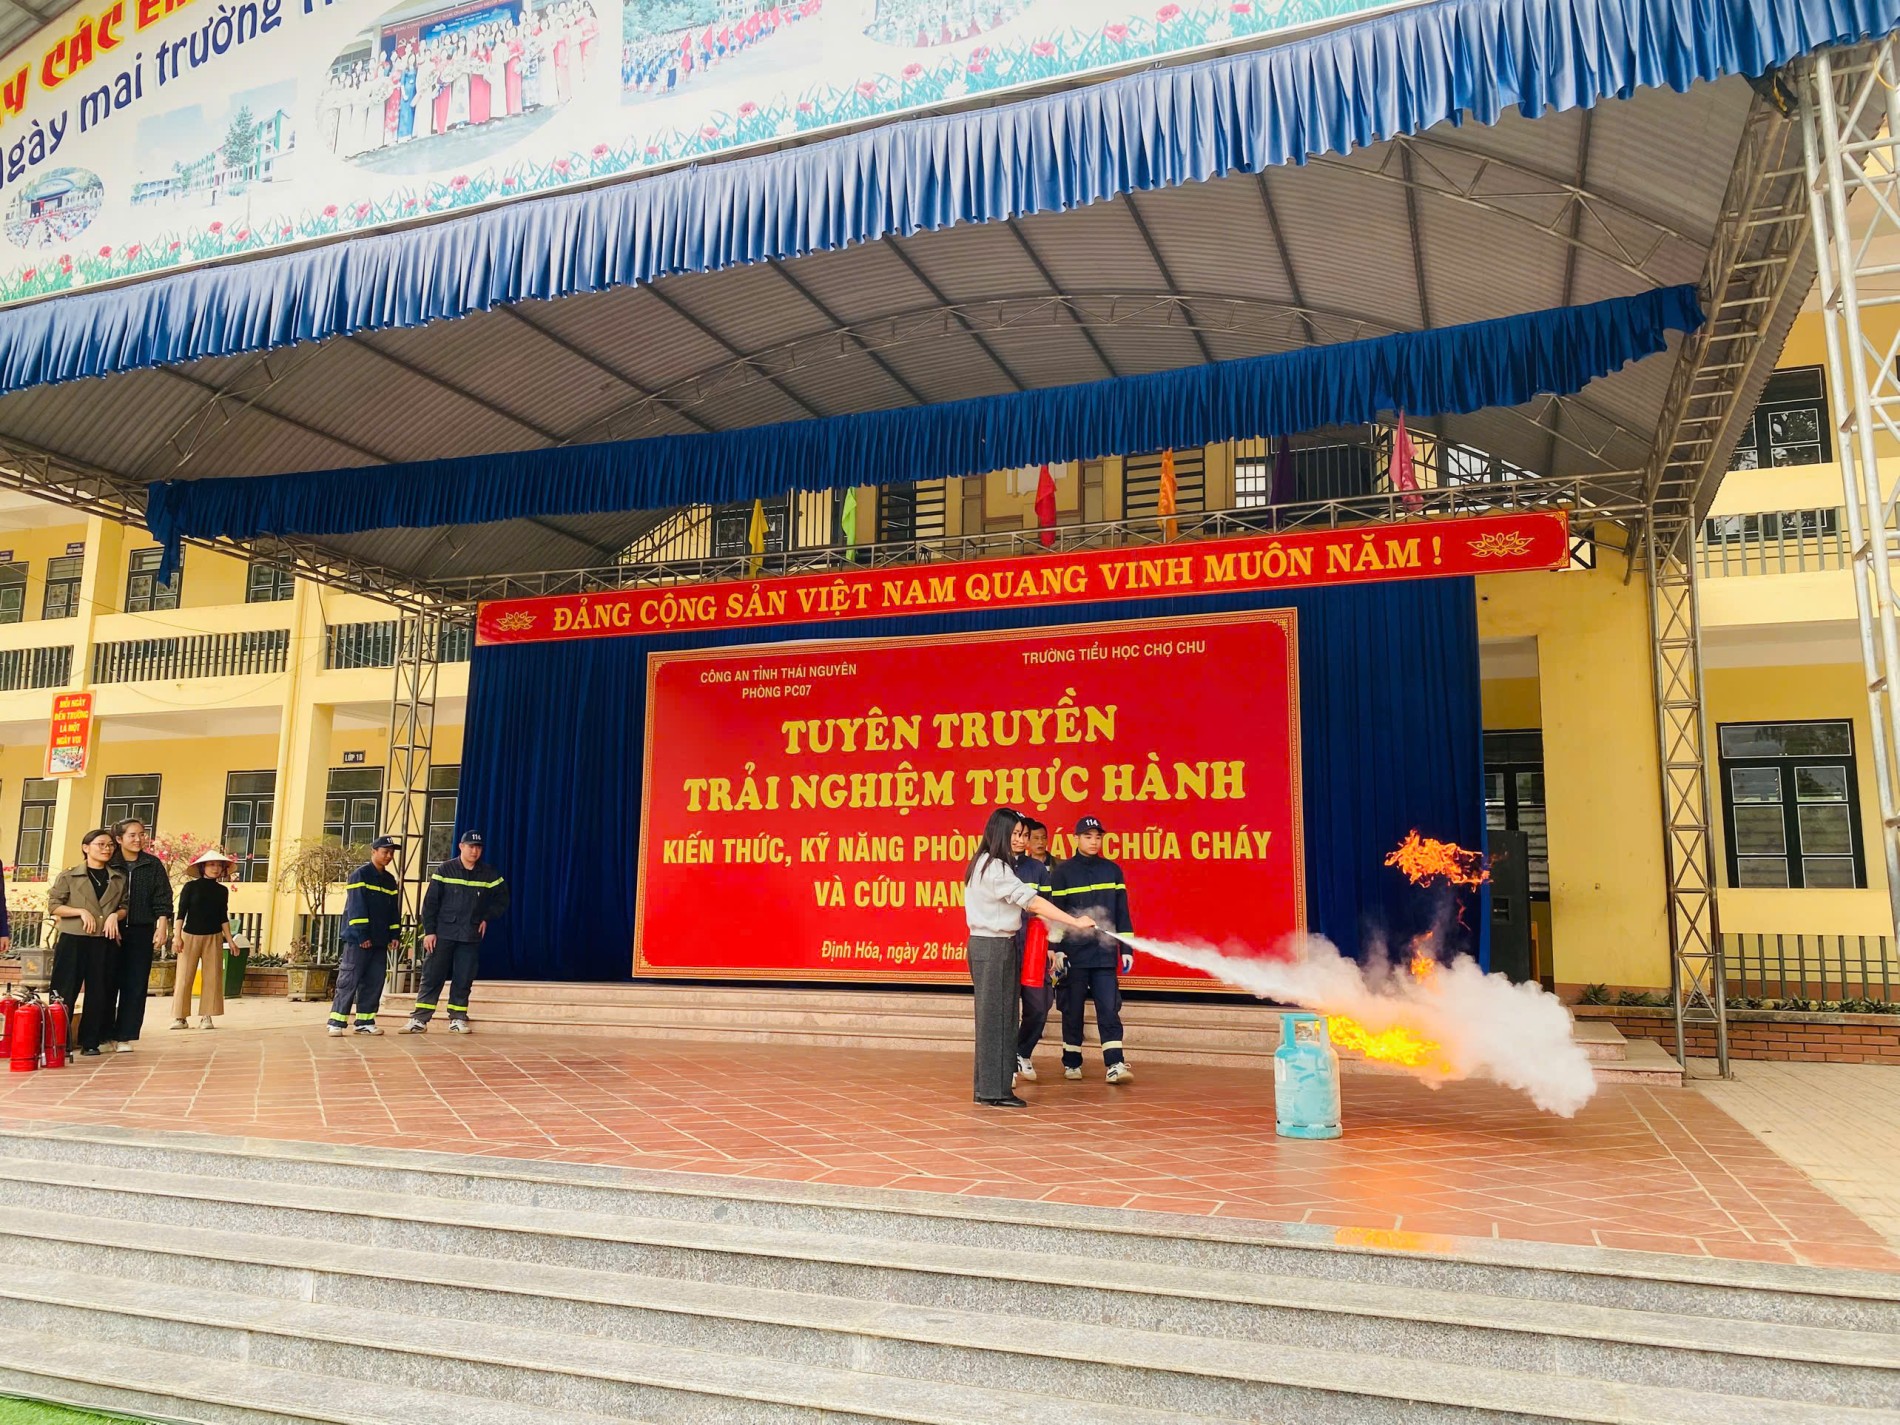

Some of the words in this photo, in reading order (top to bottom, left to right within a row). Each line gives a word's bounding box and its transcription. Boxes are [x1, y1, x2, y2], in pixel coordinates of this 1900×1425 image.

[0, 66, 29, 116] Y
[42, 2, 123, 87] CÁC
[138, 0, 187, 29] E
[80, 52, 143, 133] mai
[155, 0, 282, 87] trường
[553, 596, 632, 631] ĐẢNG
[640, 592, 716, 629] CỘNG
[725, 583, 786, 618] SẢN
[796, 578, 872, 616] VIỆT
[881, 576, 956, 606] NAM
[966, 564, 1088, 602] QUANG
[1099, 557, 1193, 590] VINH
[1204, 542, 1314, 584] MUÔN
[1326, 535, 1421, 574] NĂM
[1431, 536, 1442, 565] !
[700, 669, 732, 684] CÔNG
[734, 670, 750, 682] AN
[752, 664, 778, 681] TỈNH
[781, 664, 806, 679] THÁI
[809, 661, 857, 677] NGUYÊN
[1022, 648, 1075, 665] TRƯỜNG
[1079, 641, 1108, 661] TIỂU
[1112, 644, 1140, 660] HỌC
[1143, 641, 1173, 658] CHỢ
[1176, 640, 1206, 654] CHU
[742, 684, 781, 699] PHÒNG
[784, 684, 812, 697] PC07
[781, 706, 922, 755] TUYÊN
[933, 687, 1118, 749] TRUYỀN
[683, 761, 780, 812] TRẢI
[790, 760, 955, 816] NGHIỆM
[965, 757, 1089, 812] THỰC
[1101, 751, 1246, 802] HÀNH
[663, 830, 714, 864] KIẾN
[722, 832, 792, 867] THỨC,
[801, 832, 830, 862] KỸ
[838, 832, 904, 862] NĂNG
[913, 828, 984, 862] PHÒN
[1103, 826, 1182, 860] CHỮA
[1190, 824, 1272, 860] CHÁY
[814, 875, 846, 907] VÀ
[854, 875, 906, 908] CỨU
[915, 881, 965, 914] NẠN
[821, 940, 851, 962] Định
[855, 941, 882, 962] Hóa,
[887, 941, 920, 964] ngày
[922, 942, 938, 960] 28
